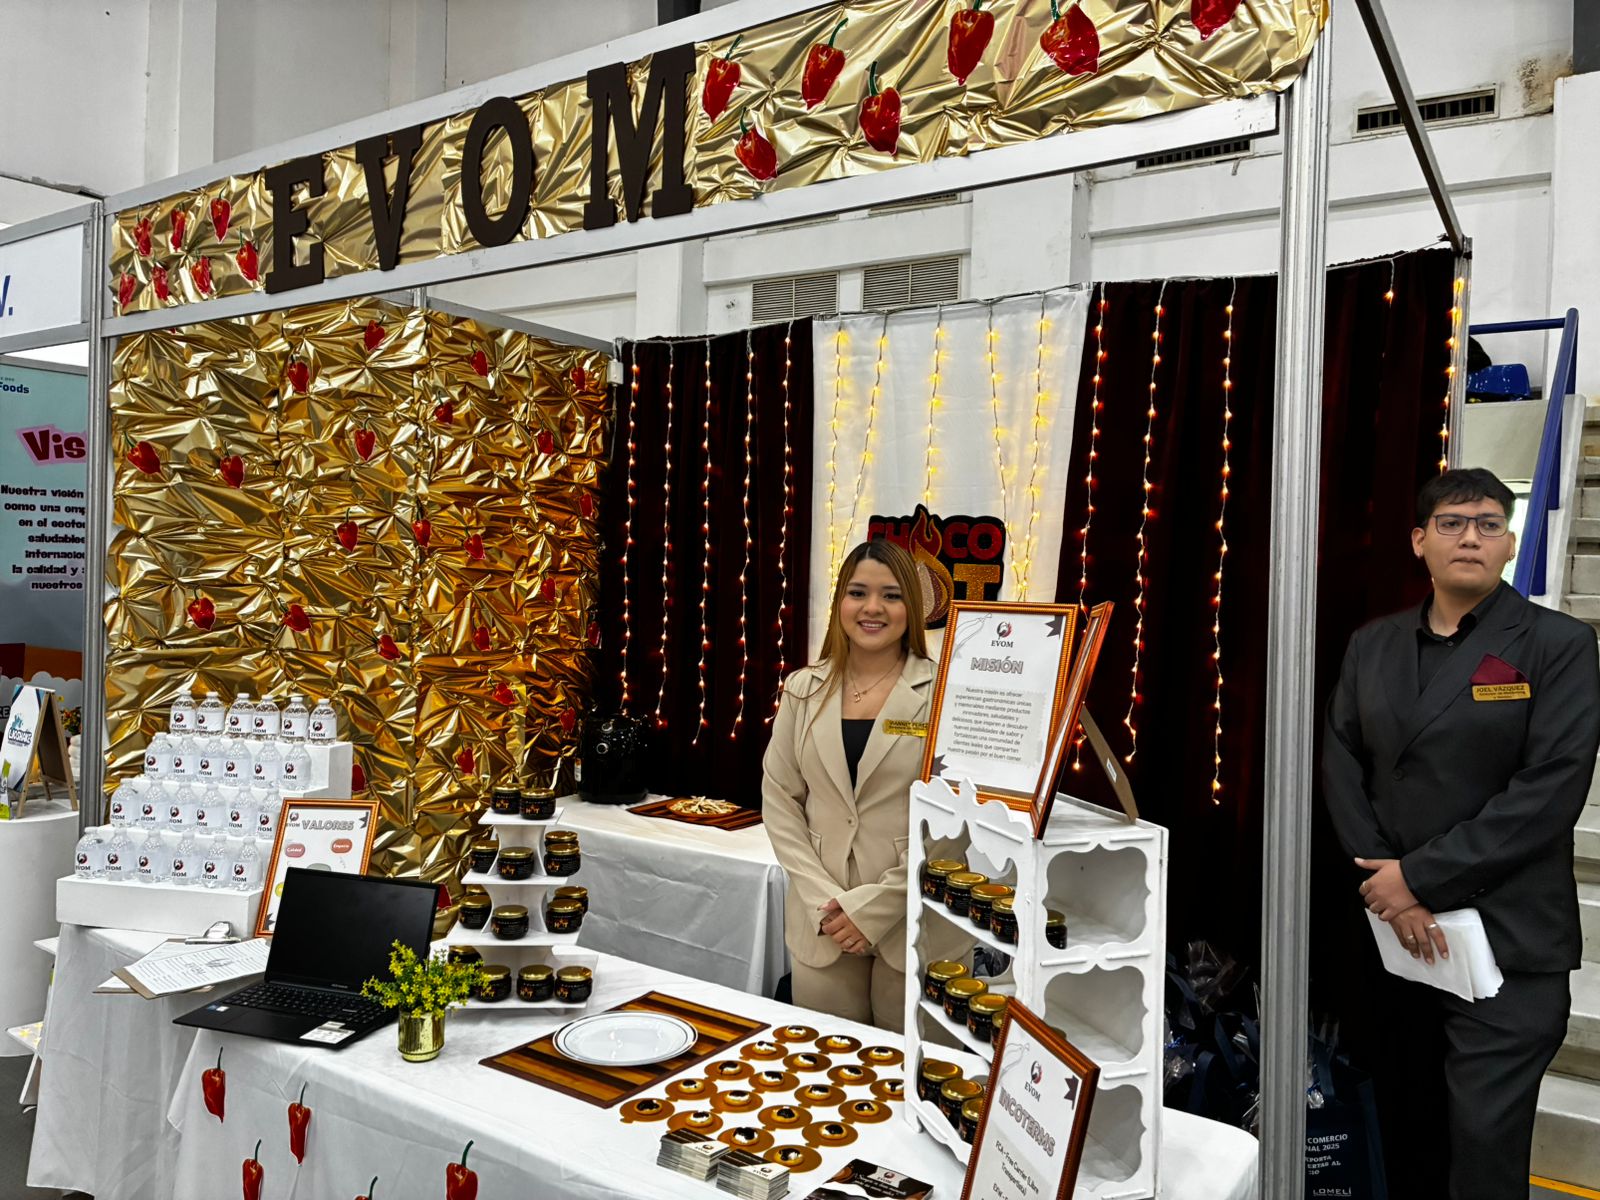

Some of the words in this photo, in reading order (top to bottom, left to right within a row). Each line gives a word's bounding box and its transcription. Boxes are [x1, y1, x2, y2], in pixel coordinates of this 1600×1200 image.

[265, 42, 697, 294] EVOM
[0, 485, 47, 496] Nuestra
[51, 489, 84, 498] visión
[4, 503, 36, 511] como
[40, 504, 61, 512] una
[37, 518, 48, 527] el
[25, 549, 85, 559] internacio
[12, 564, 22, 573] la
[27, 565, 67, 574] calidad
[70, 567, 78, 576] y
[31, 580, 83, 589] nuestros
[991, 640, 1014, 648] EVOM
[970, 656, 1024, 674] MISIÓN
[302, 820, 354, 830] VALORES
[1024, 1081, 1041, 1102] EVOM
[999, 1086, 1056, 1157] INCOTERMS
[1307, 1133, 1348, 1144] COMERCIO
[995, 1140, 1004, 1154] FCA
[1322, 1143, 1340, 1151] 2025
